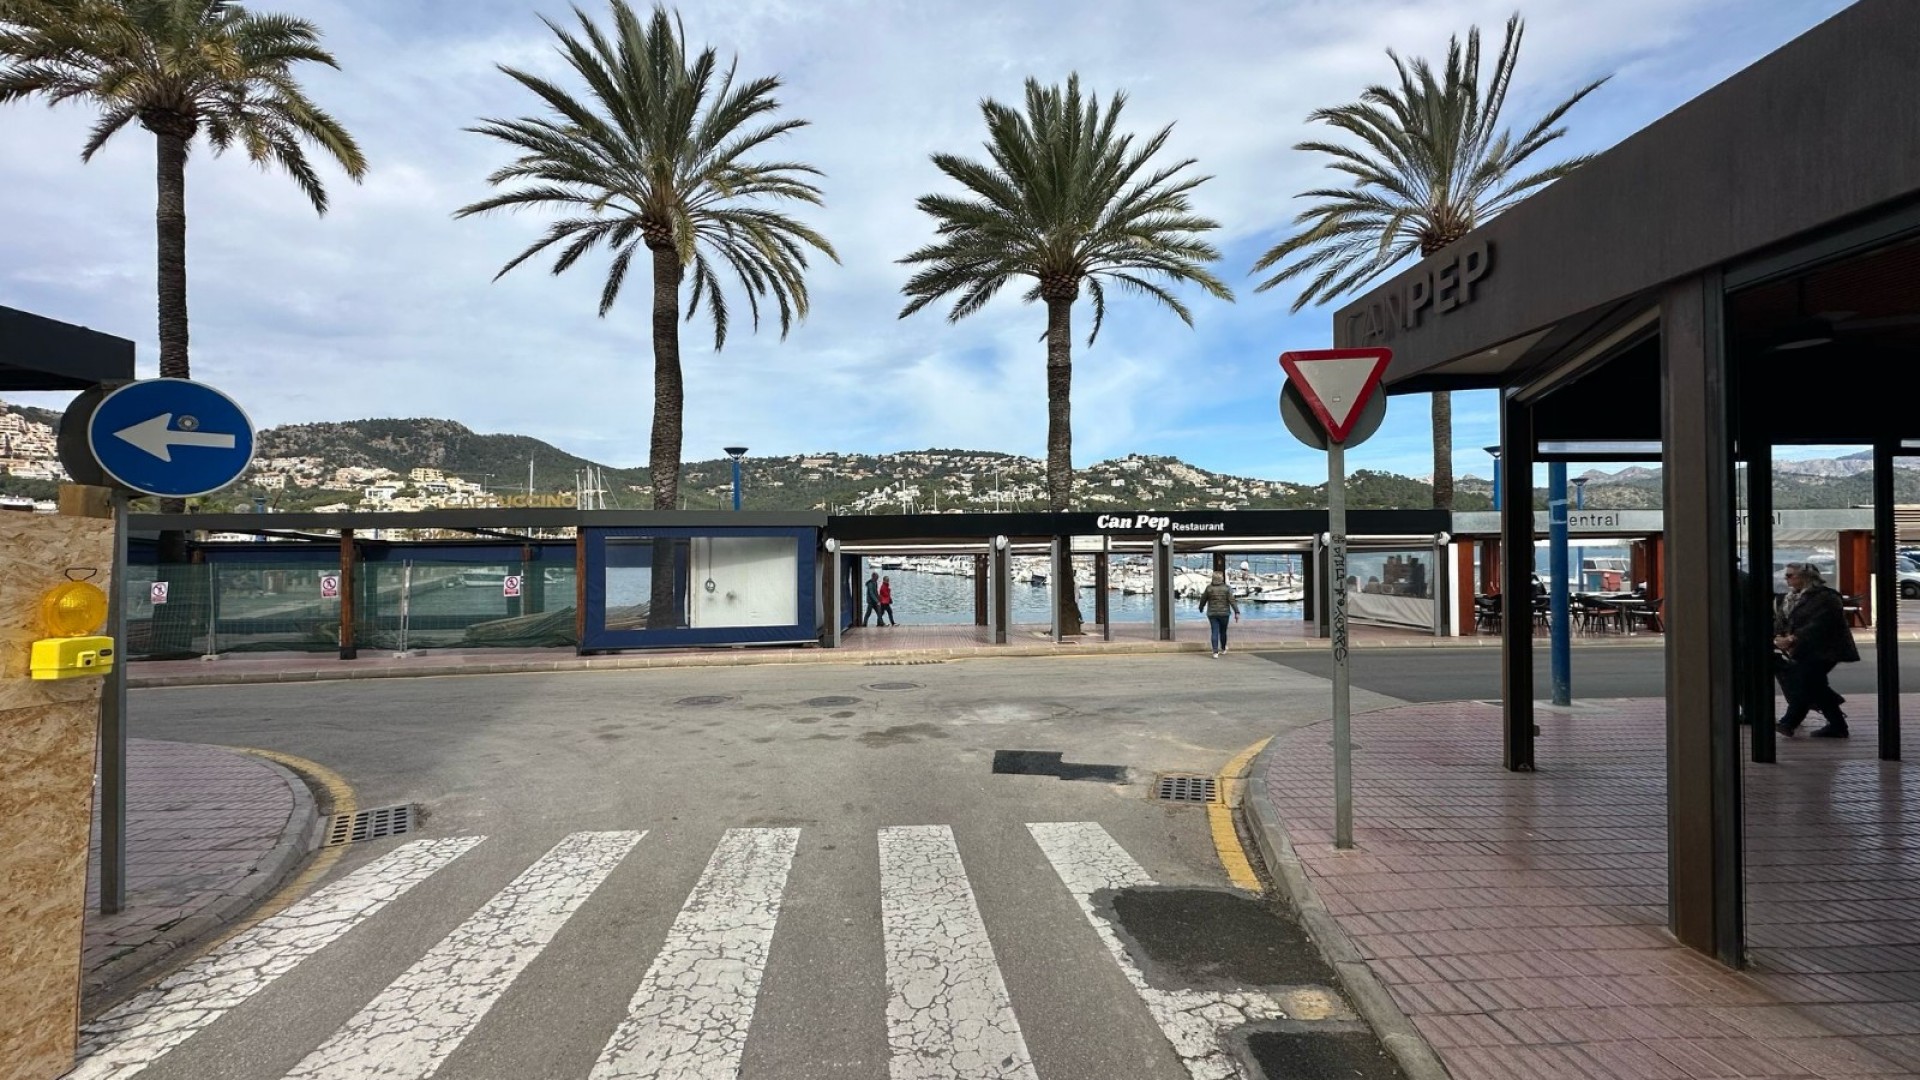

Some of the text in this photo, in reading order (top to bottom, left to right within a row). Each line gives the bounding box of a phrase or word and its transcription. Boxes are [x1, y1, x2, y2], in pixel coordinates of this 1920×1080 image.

[443, 495, 577, 508] CAPPUCCINO
[1096, 514, 1225, 531] Can Pep Restaurant
[1569, 513, 1619, 526] entral
